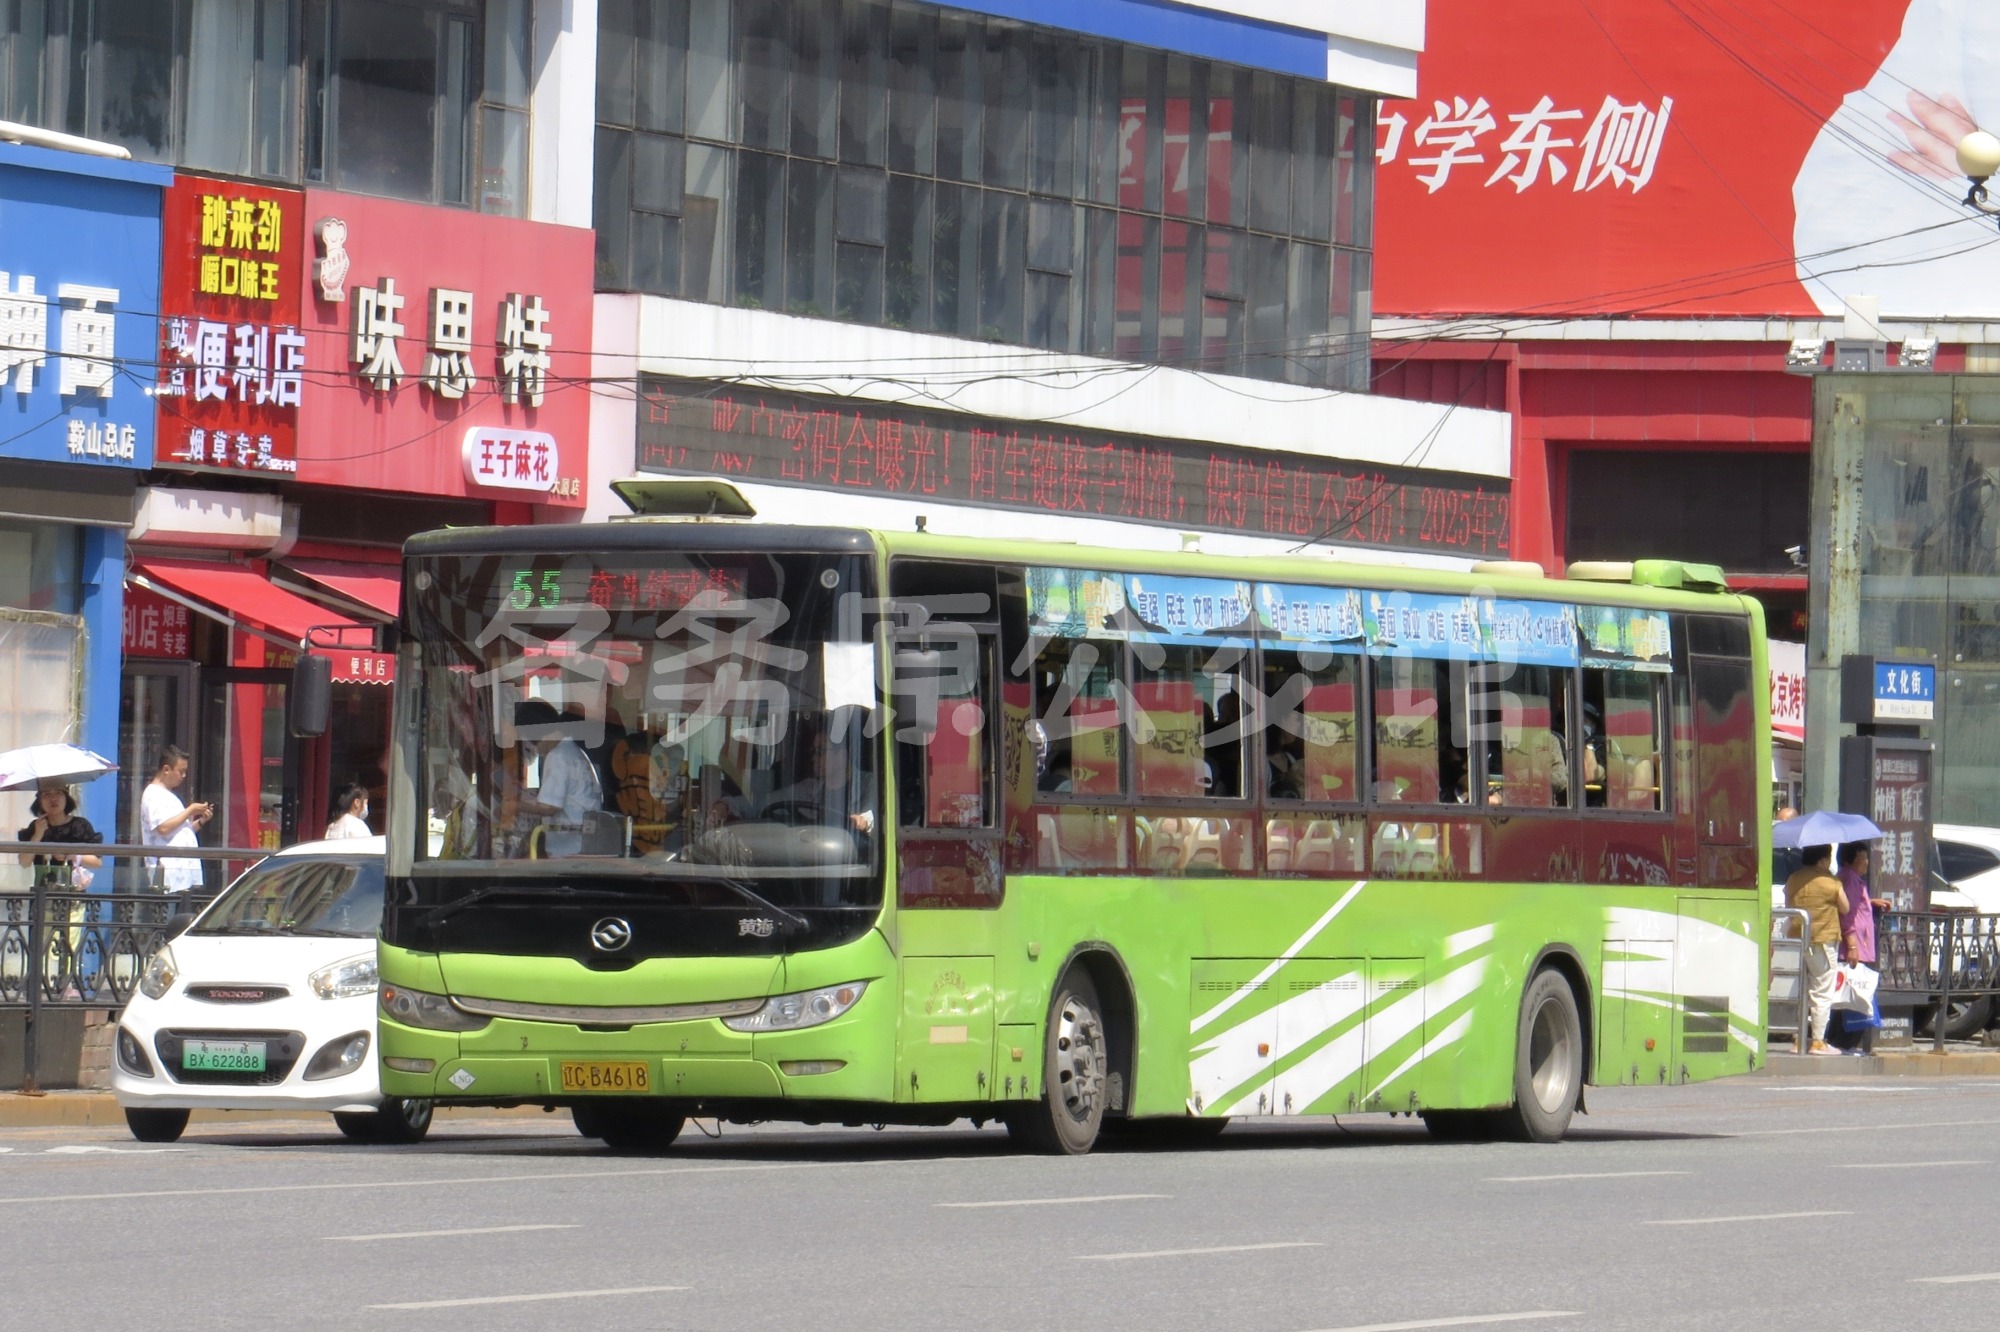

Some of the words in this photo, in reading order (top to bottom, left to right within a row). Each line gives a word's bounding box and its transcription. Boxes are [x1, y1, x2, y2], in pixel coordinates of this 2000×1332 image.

[202, 194, 281, 253] 秒来劲
[349, 277, 553, 408] 味思特
[193, 317, 306, 407] 便利店
[67, 419, 136, 460] 鞍山总店
[190, 428, 272, 467] 烟草专卖
[479, 439, 549, 482] 王子麻花
[510, 570, 562, 610] 55
[162, 604, 187, 627] 烟草
[1138, 592, 1159, 626] 富强
[1166, 593, 1187, 627] 民主
[1193, 595, 1214, 628] 文明
[1270, 601, 1288, 632] 自由
[1292, 602, 1310, 634] 平等
[1315, 603, 1332, 635] 公正
[1377, 608, 1397, 639] 爱国
[1402, 608, 1421, 640] 敬业
[1427, 610, 1446, 642] 诚信
[1451, 612, 1470, 643] 友善
[162, 632, 187, 656] 专卖
[351, 656, 386, 676] 便利店
[1887, 668, 1921, 695] 文化街
[1874, 787, 1897, 822] 种植
